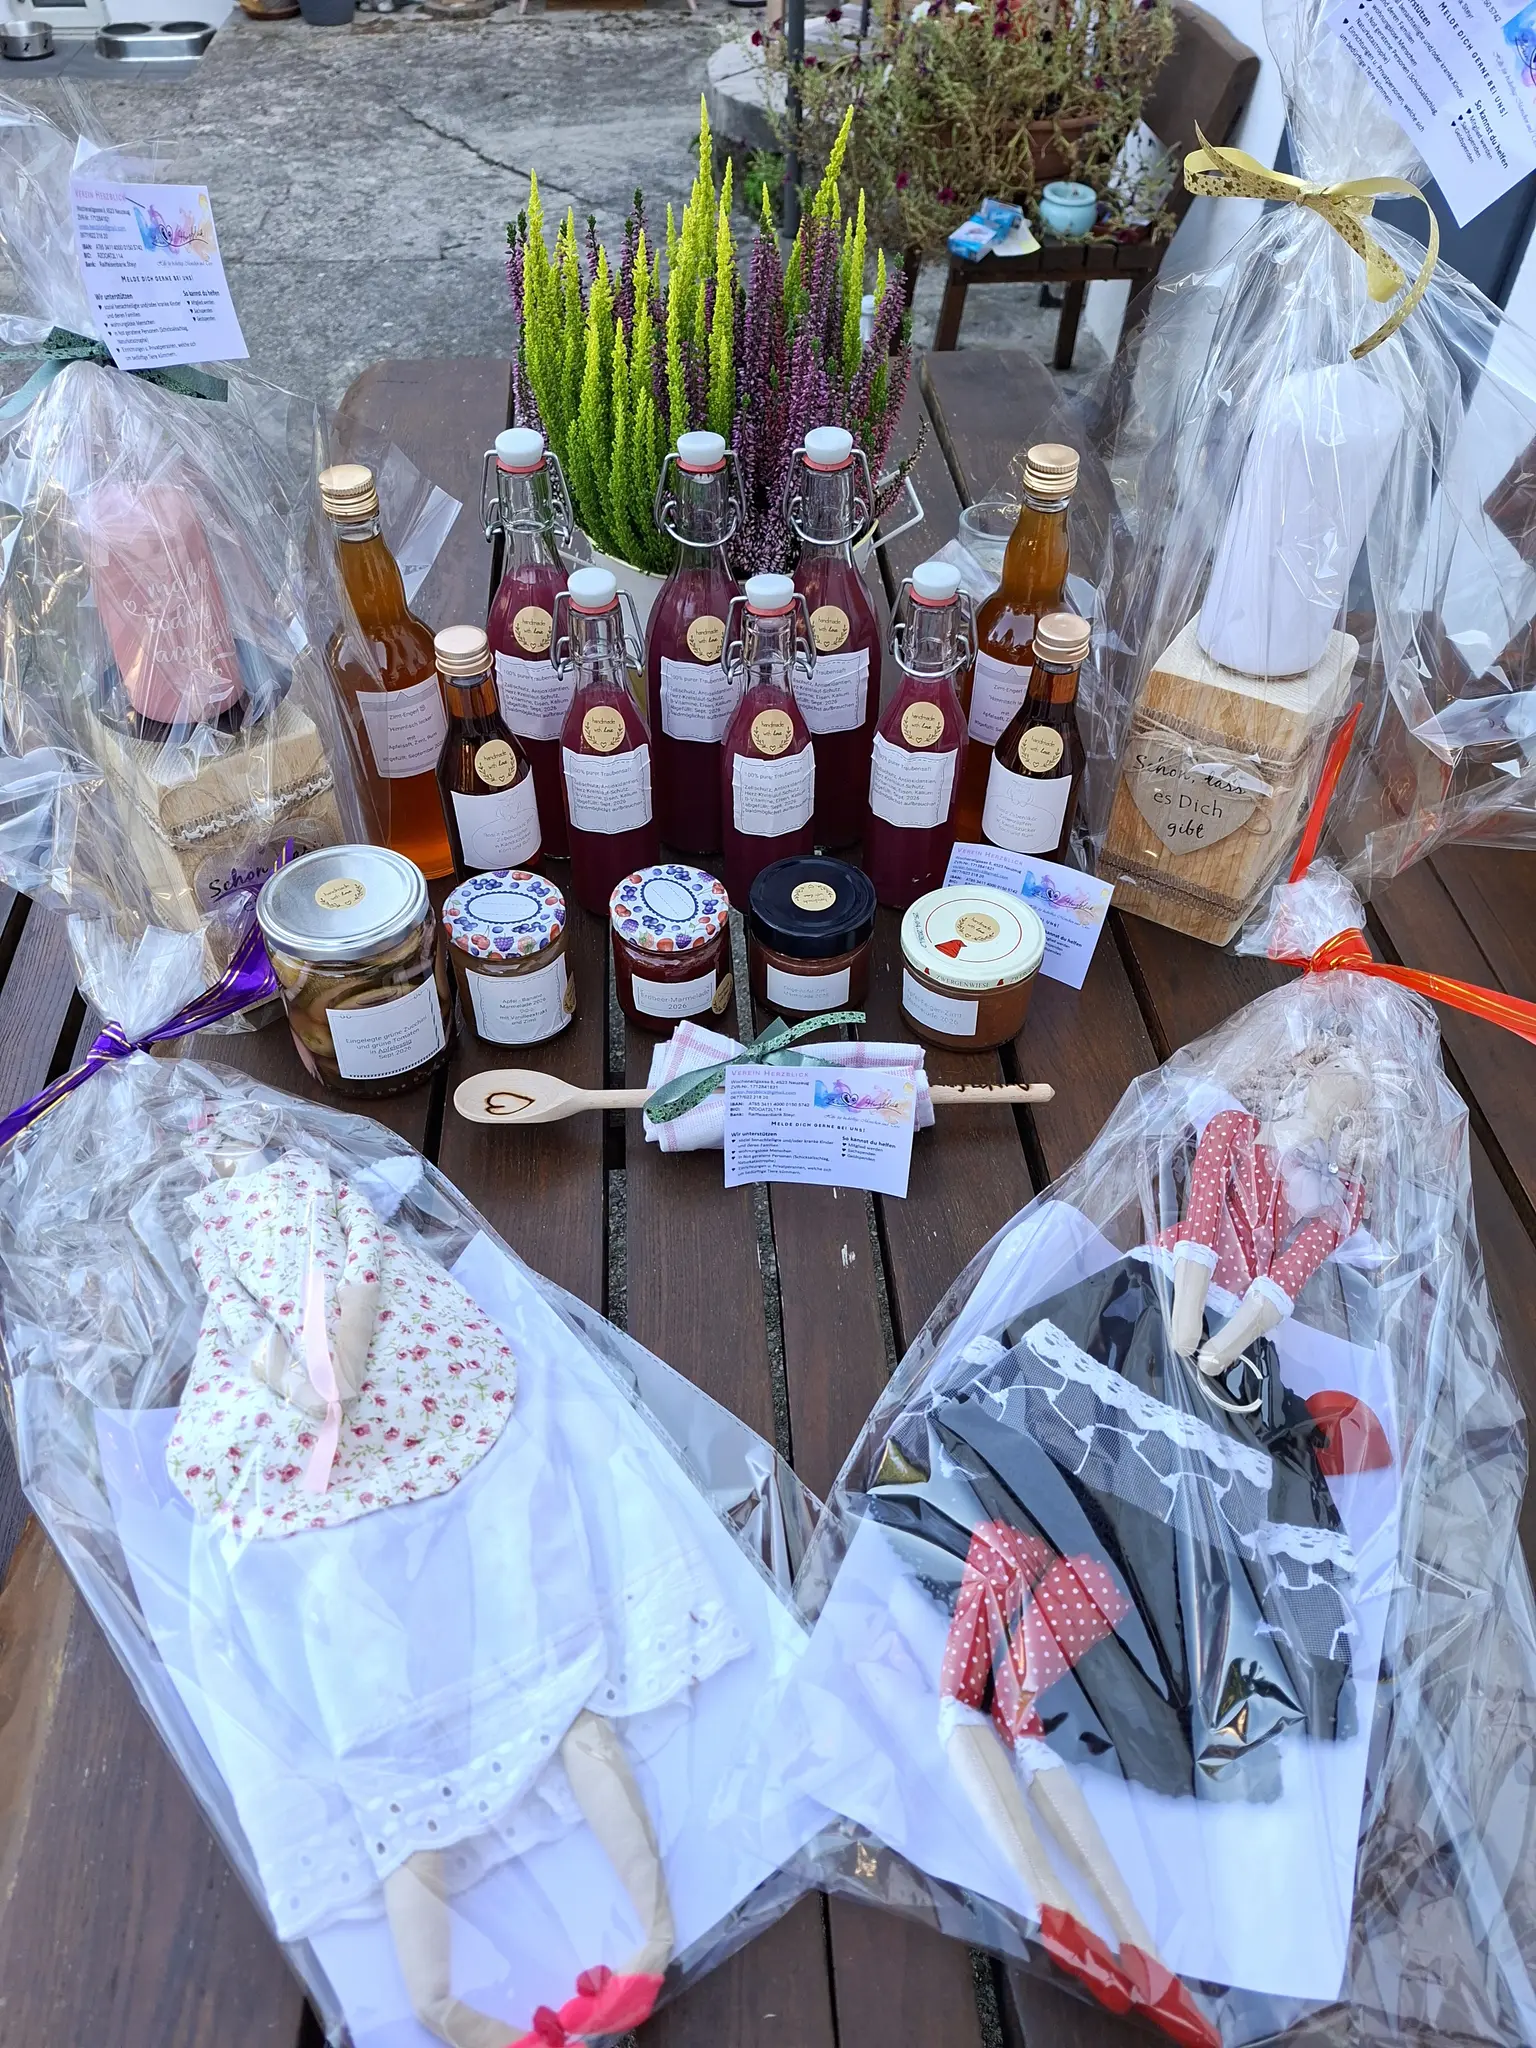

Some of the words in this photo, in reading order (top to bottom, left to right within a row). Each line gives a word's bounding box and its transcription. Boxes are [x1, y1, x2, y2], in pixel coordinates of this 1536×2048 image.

[1372, 4, 1399, 40] wohnungslose
[1397, 39, 1417, 66] Menschen
[1387, 6, 1400, 23] deren
[1397, 21, 1415, 44] Familien
[1367, 16, 1377, 29] Not
[1374, 27, 1393, 50] geratene
[1391, 49, 1410, 74] Personen
[1398, 3, 1425, 40] benachteiligte
[1423, 39, 1442, 63] und/oder
[1440, 62, 1454, 82] kranke
[1451, 79, 1465, 99] Kinder
[1438, 1, 1460, 30] MELDE
[1457, 30, 1474, 51] DICH
[1471, 51, 1490, 80] GERNE
[1487, 80, 1498, 95] BEI
[1494, 95, 1509, 117] UNS!
[1347, 25, 1374, 60] Einrichtungen
[1403, 103, 1419, 122] welche
[1415, 120, 1425, 133] sich
[1365, 65, 1376, 80] Tiere
[1461, 121, 1481, 158] Sachspenden
[1470, 115, 1483, 139] Mitglied
[1479, 137, 1493, 160] werden
[1474, 99, 1482, 110] So
[1479, 109, 1494, 135] kannst
[1490, 134, 1497, 146] du
[1494, 144, 1509, 169] helfen
[1454, 127, 1475, 164] Geldspenden
[521, 618, 546, 627] handmade
[818, 616, 841, 625] handmade
[696, 628, 719, 636] handmade
[591, 717, 616, 725] handmade
[911, 712, 935, 721] handmade
[1031, 735, 1055, 747] handmade
[483, 750, 507, 761] handmade
[1153, 791, 1172, 805] es
[1179, 794, 1223, 818] Dich
[1167, 819, 1205, 839] gibt
[957, 847, 983, 856] VEREIN
[984, 851, 1024, 866] HERZBLICK
[345, 1036, 382, 1045] Eingelegte
[383, 1030, 403, 1040] grüne
[404, 1015, 428, 1032] Zucchini
[371, 1040, 392, 1049] grüne
[393, 1028, 420, 1043] Tomaten
[378, 1039, 413, 1054] Apfelessig
[378, 1052, 394, 1060] Sept
[396, 1046, 412, 1056] 2026
[764, 1070, 809, 1078] HERZBLICK
[850, 1136, 869, 1144] kannst
[878, 1141, 897, 1149] helfen
